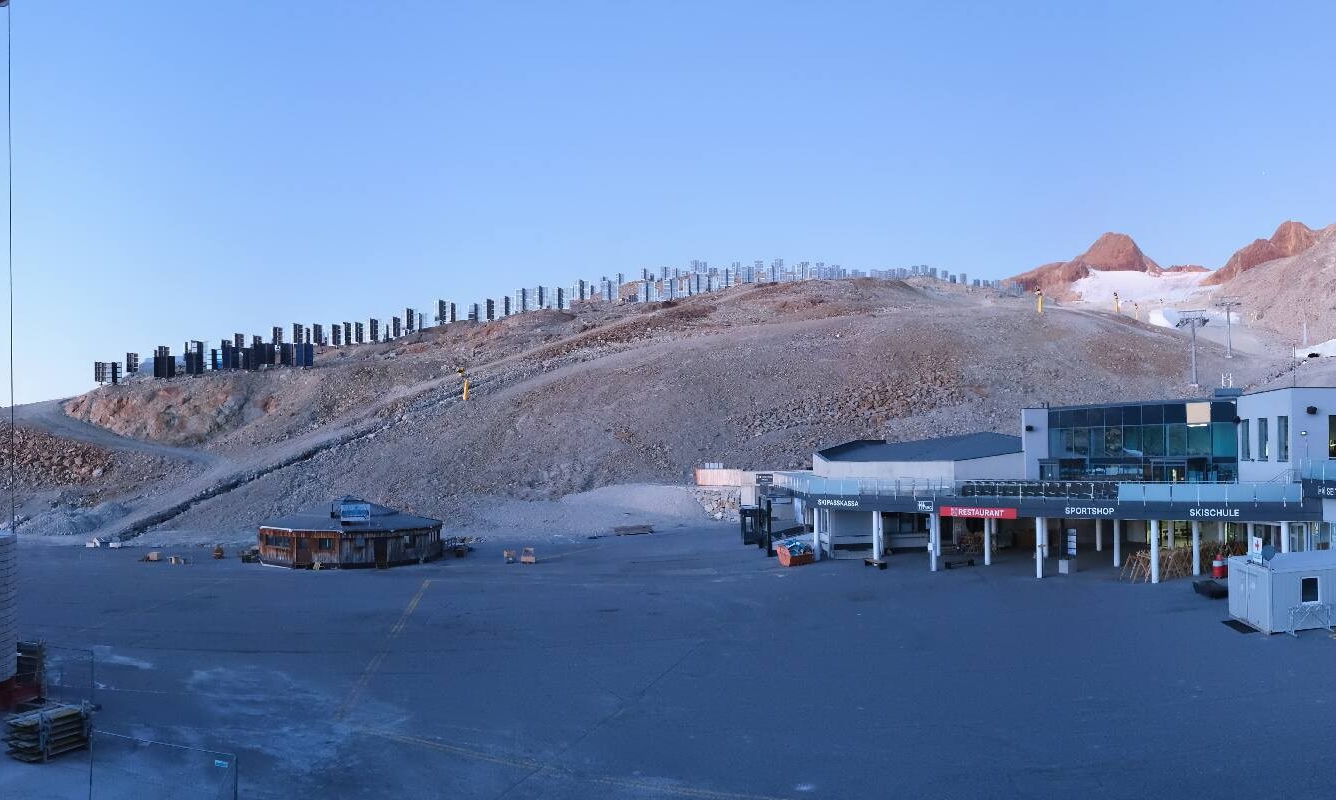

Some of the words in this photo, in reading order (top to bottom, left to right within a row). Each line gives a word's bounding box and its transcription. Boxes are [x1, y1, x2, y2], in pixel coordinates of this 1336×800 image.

[817, 499, 860, 507] SKIPASSKASSA
[958, 508, 1004, 517] RESTAURANT
[1065, 507, 1114, 515] SPORTSHOP
[1189, 508, 1240, 517] SKISCHULE
